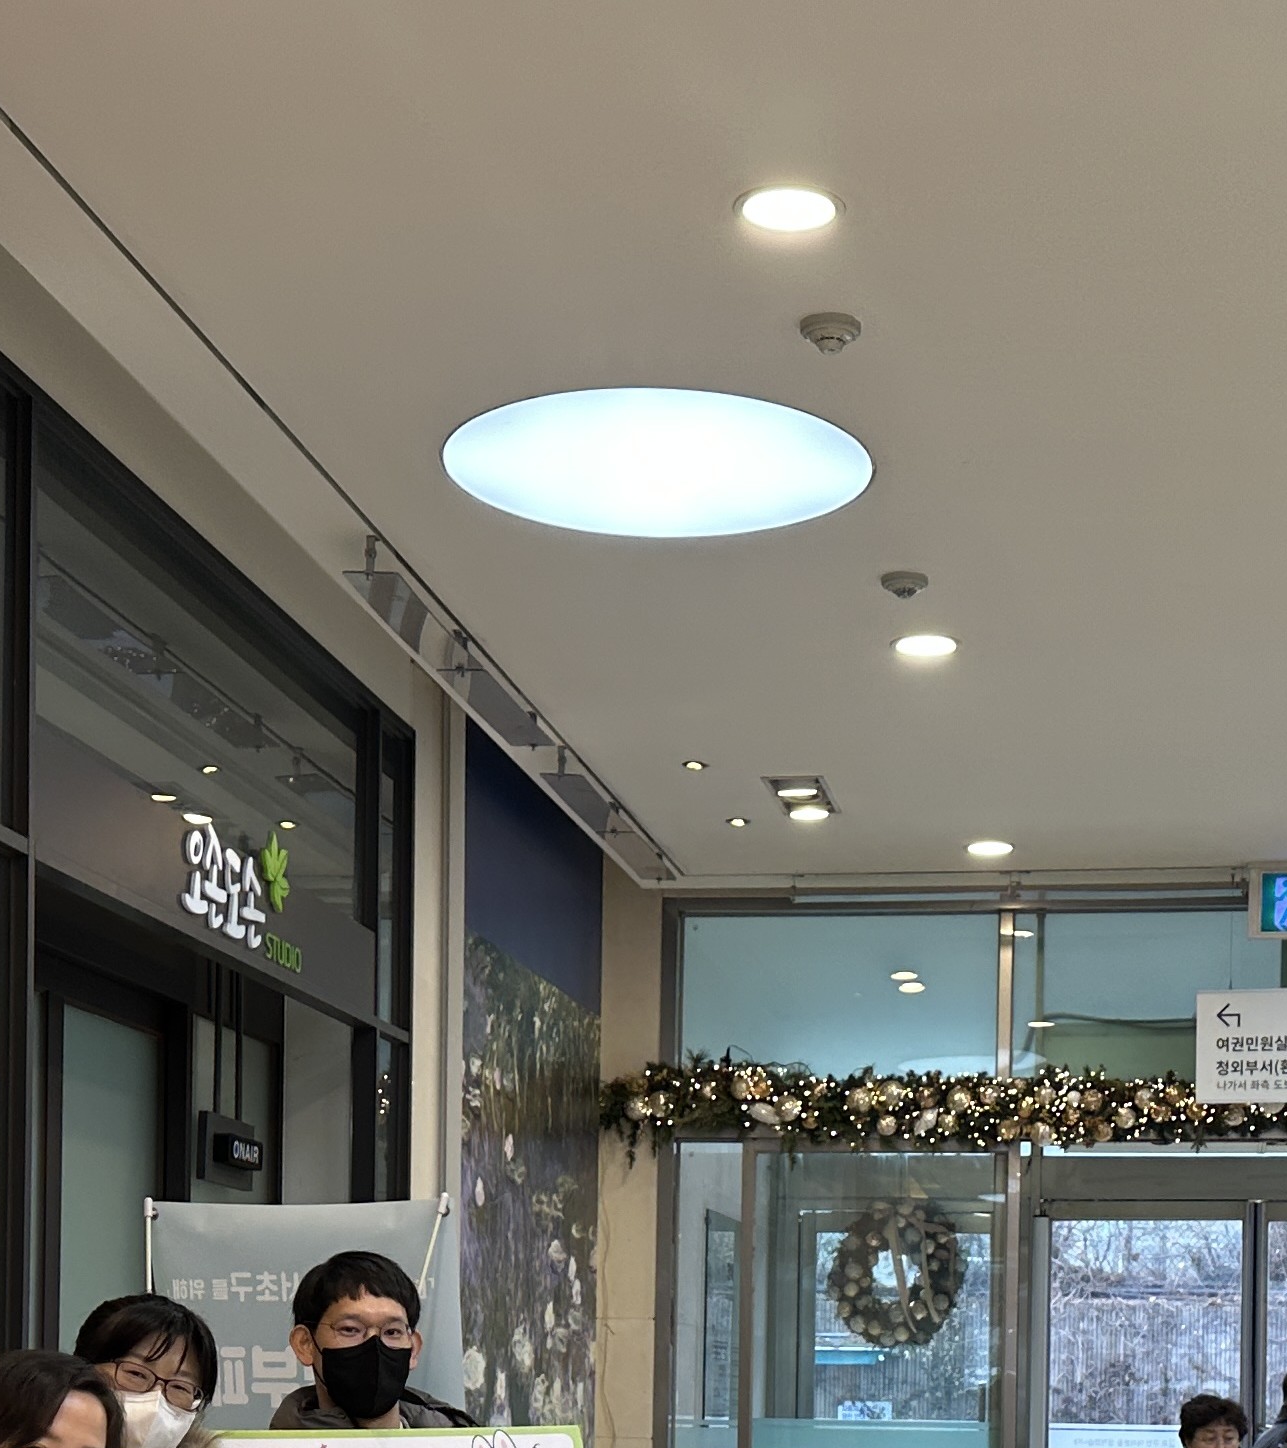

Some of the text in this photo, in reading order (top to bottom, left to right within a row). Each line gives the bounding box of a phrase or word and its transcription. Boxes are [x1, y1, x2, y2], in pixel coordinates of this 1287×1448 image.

[183, 822, 266, 949] 오손도손
[265, 932, 302, 973] STUDIO
[1216, 1035, 1287, 1052] 여권민원실
